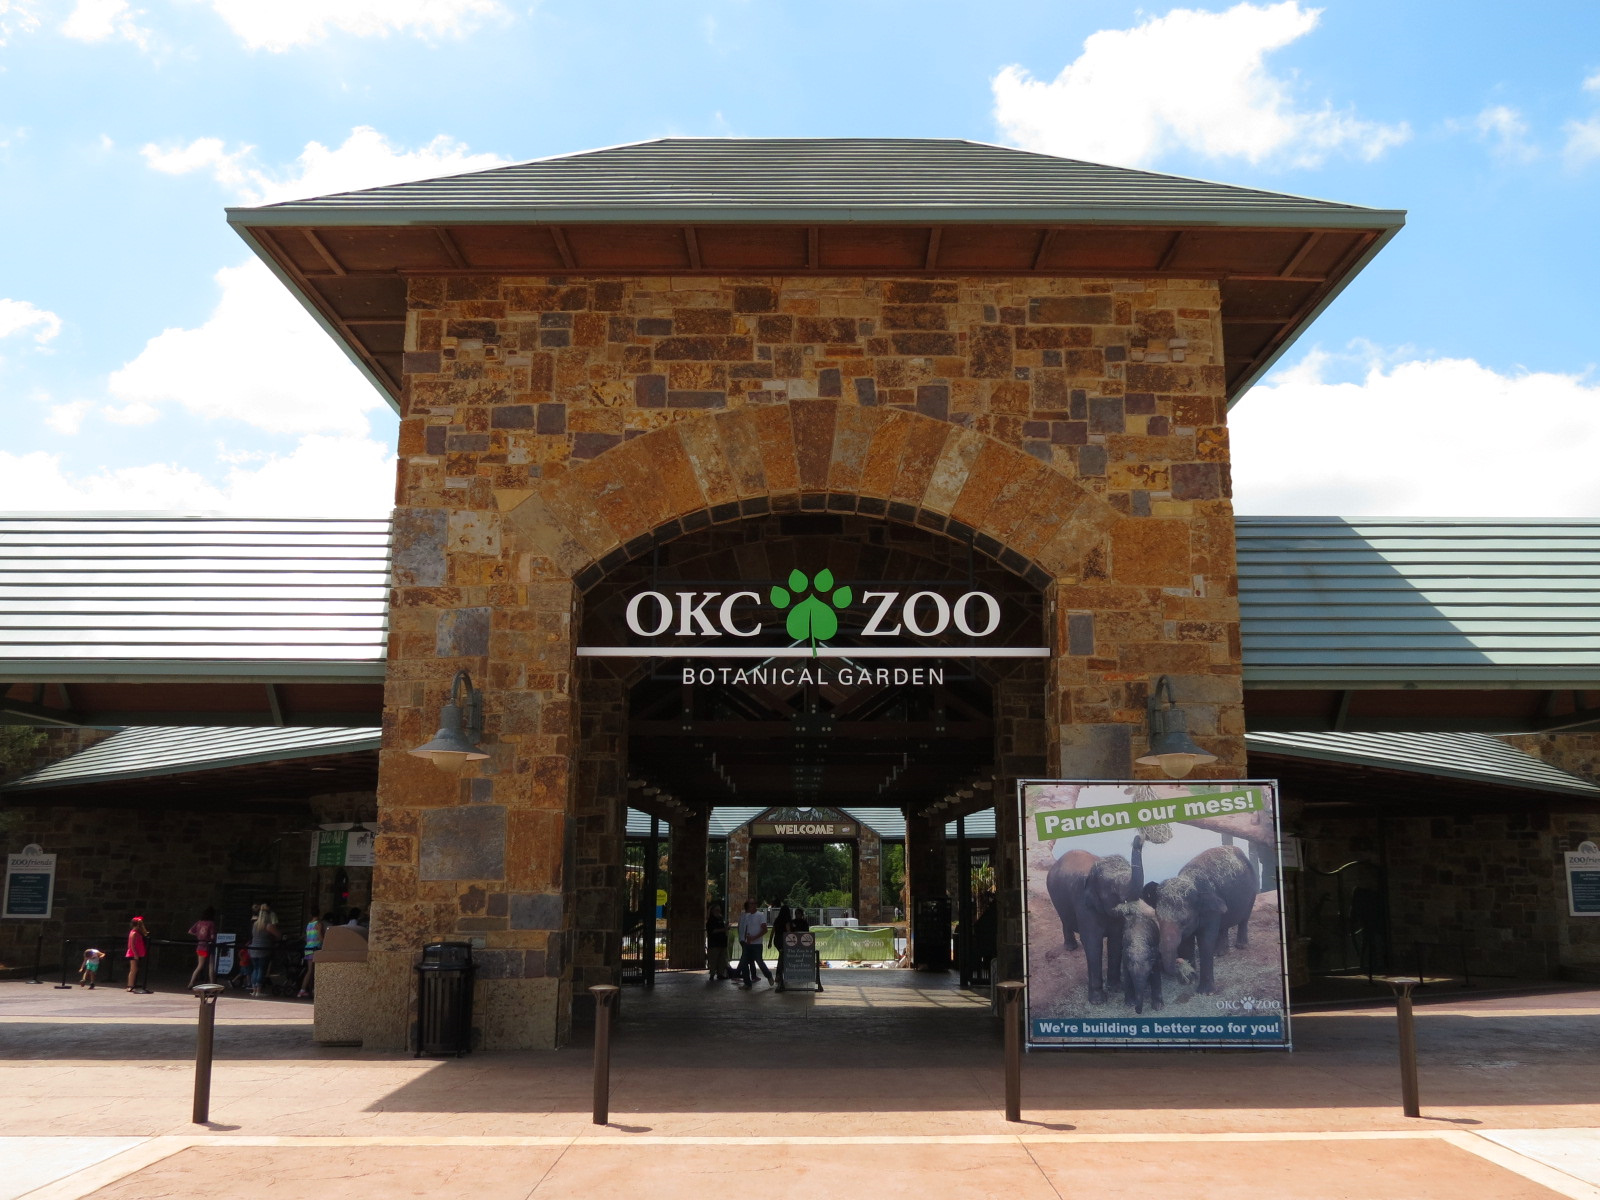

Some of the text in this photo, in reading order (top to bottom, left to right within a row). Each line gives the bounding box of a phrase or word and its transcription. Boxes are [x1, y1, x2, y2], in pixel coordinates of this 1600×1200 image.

[625, 590, 1001, 637] OKC ZOO
[682, 667, 945, 686] BOTANICAL GARDEN
[1043, 791, 1255, 834] Pardon our mess!
[774, 824, 834, 835] WELCOME
[1215, 999, 1281, 1010] OKC ZOO
[1039, 1021, 1280, 1036] We're building a better zoo for you!
